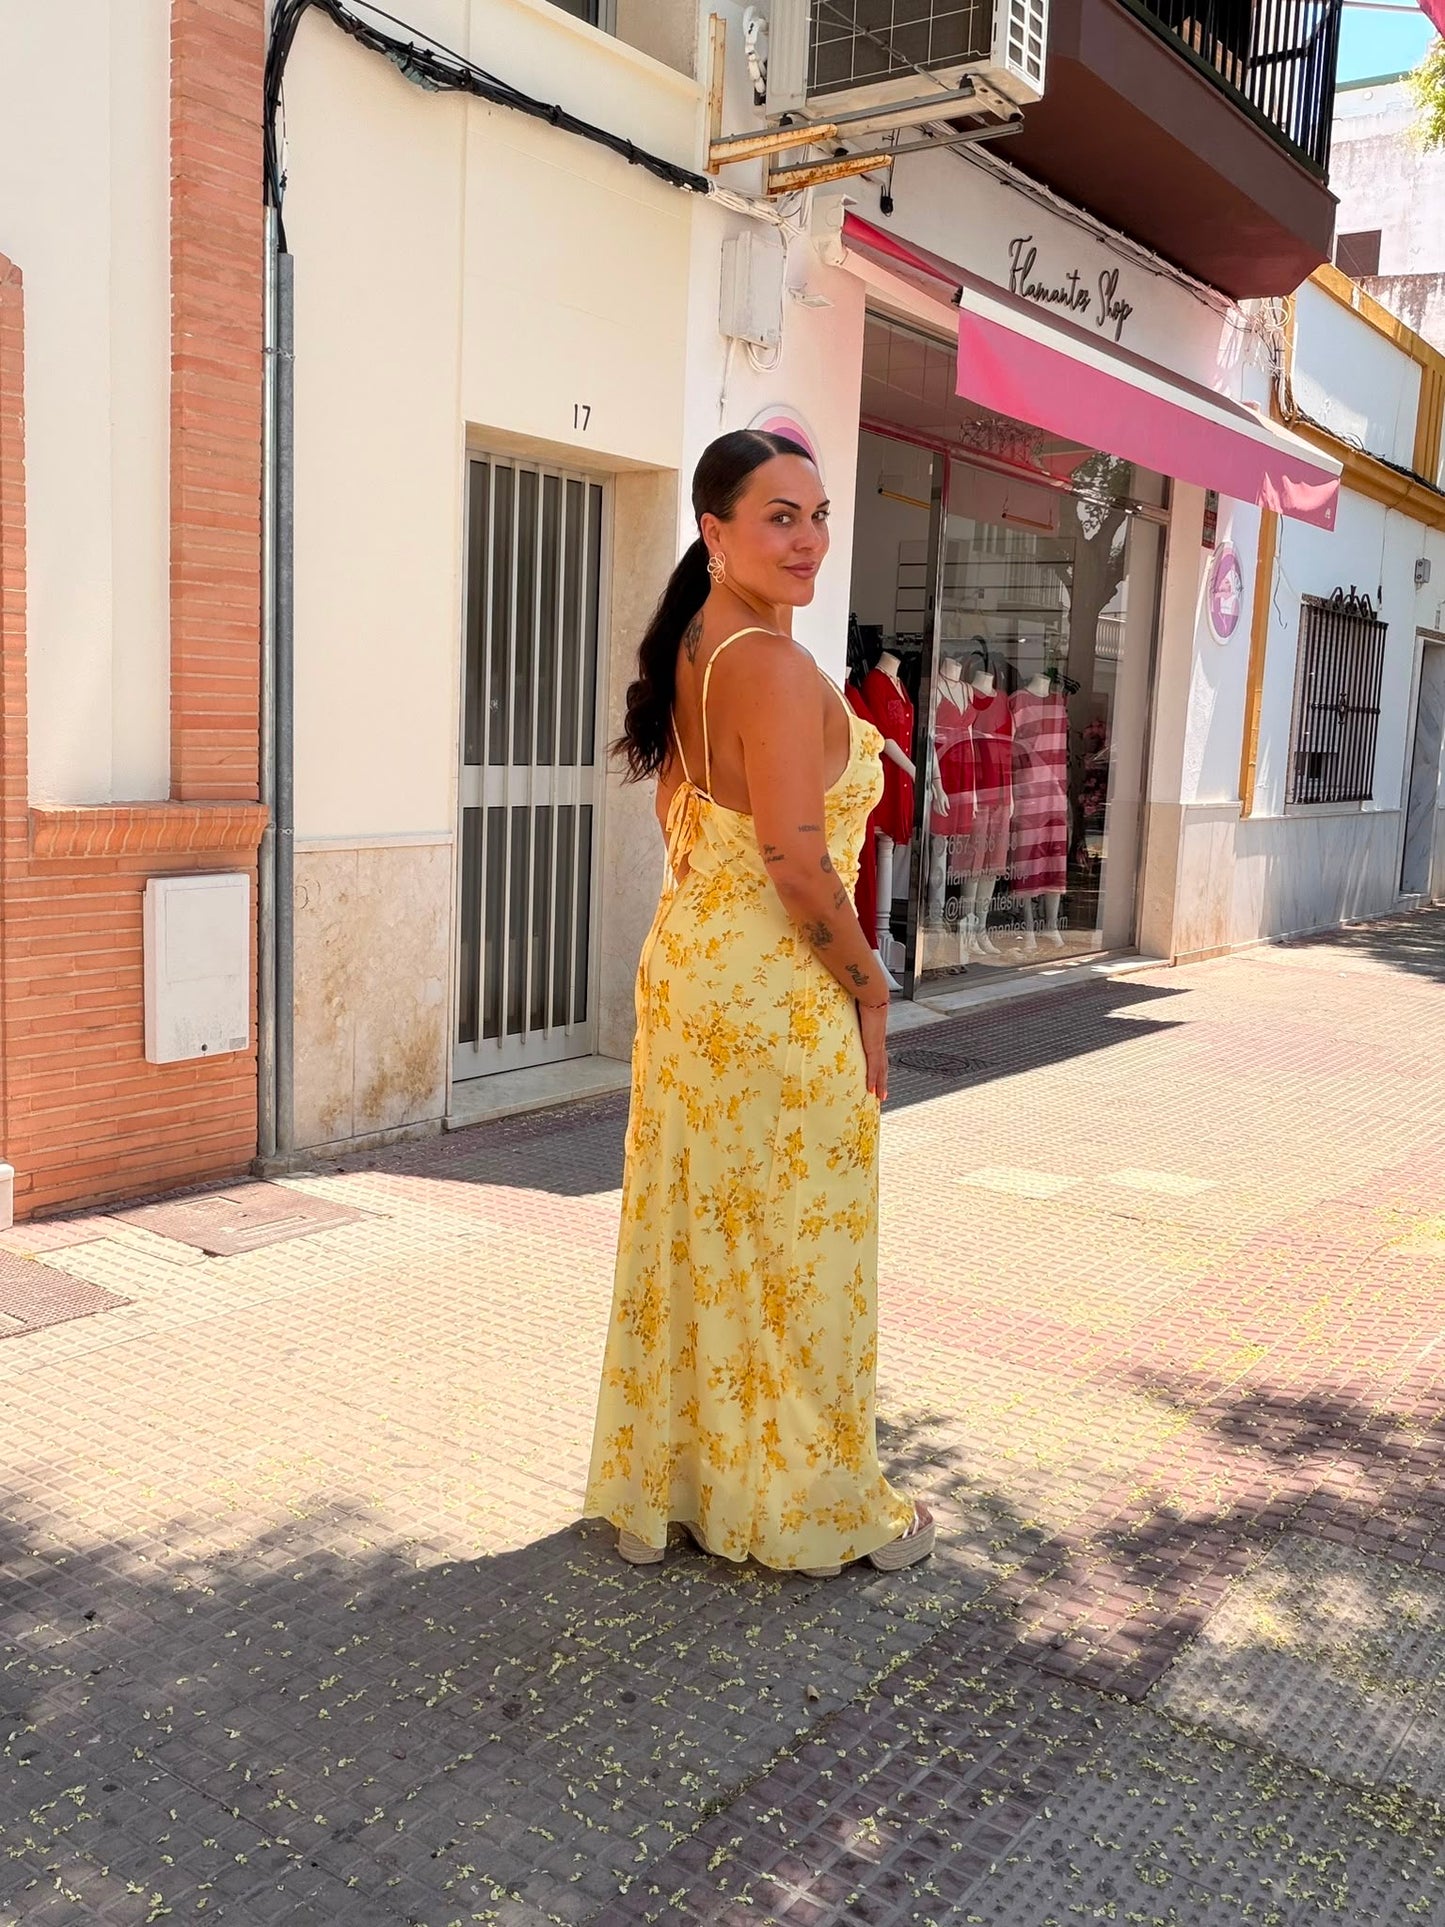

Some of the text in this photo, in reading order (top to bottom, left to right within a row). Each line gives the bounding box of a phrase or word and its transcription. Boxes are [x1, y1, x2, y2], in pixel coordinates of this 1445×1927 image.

[1008, 235, 1133, 342] Flamantes Shop
[574, 403, 591, 431] 17
